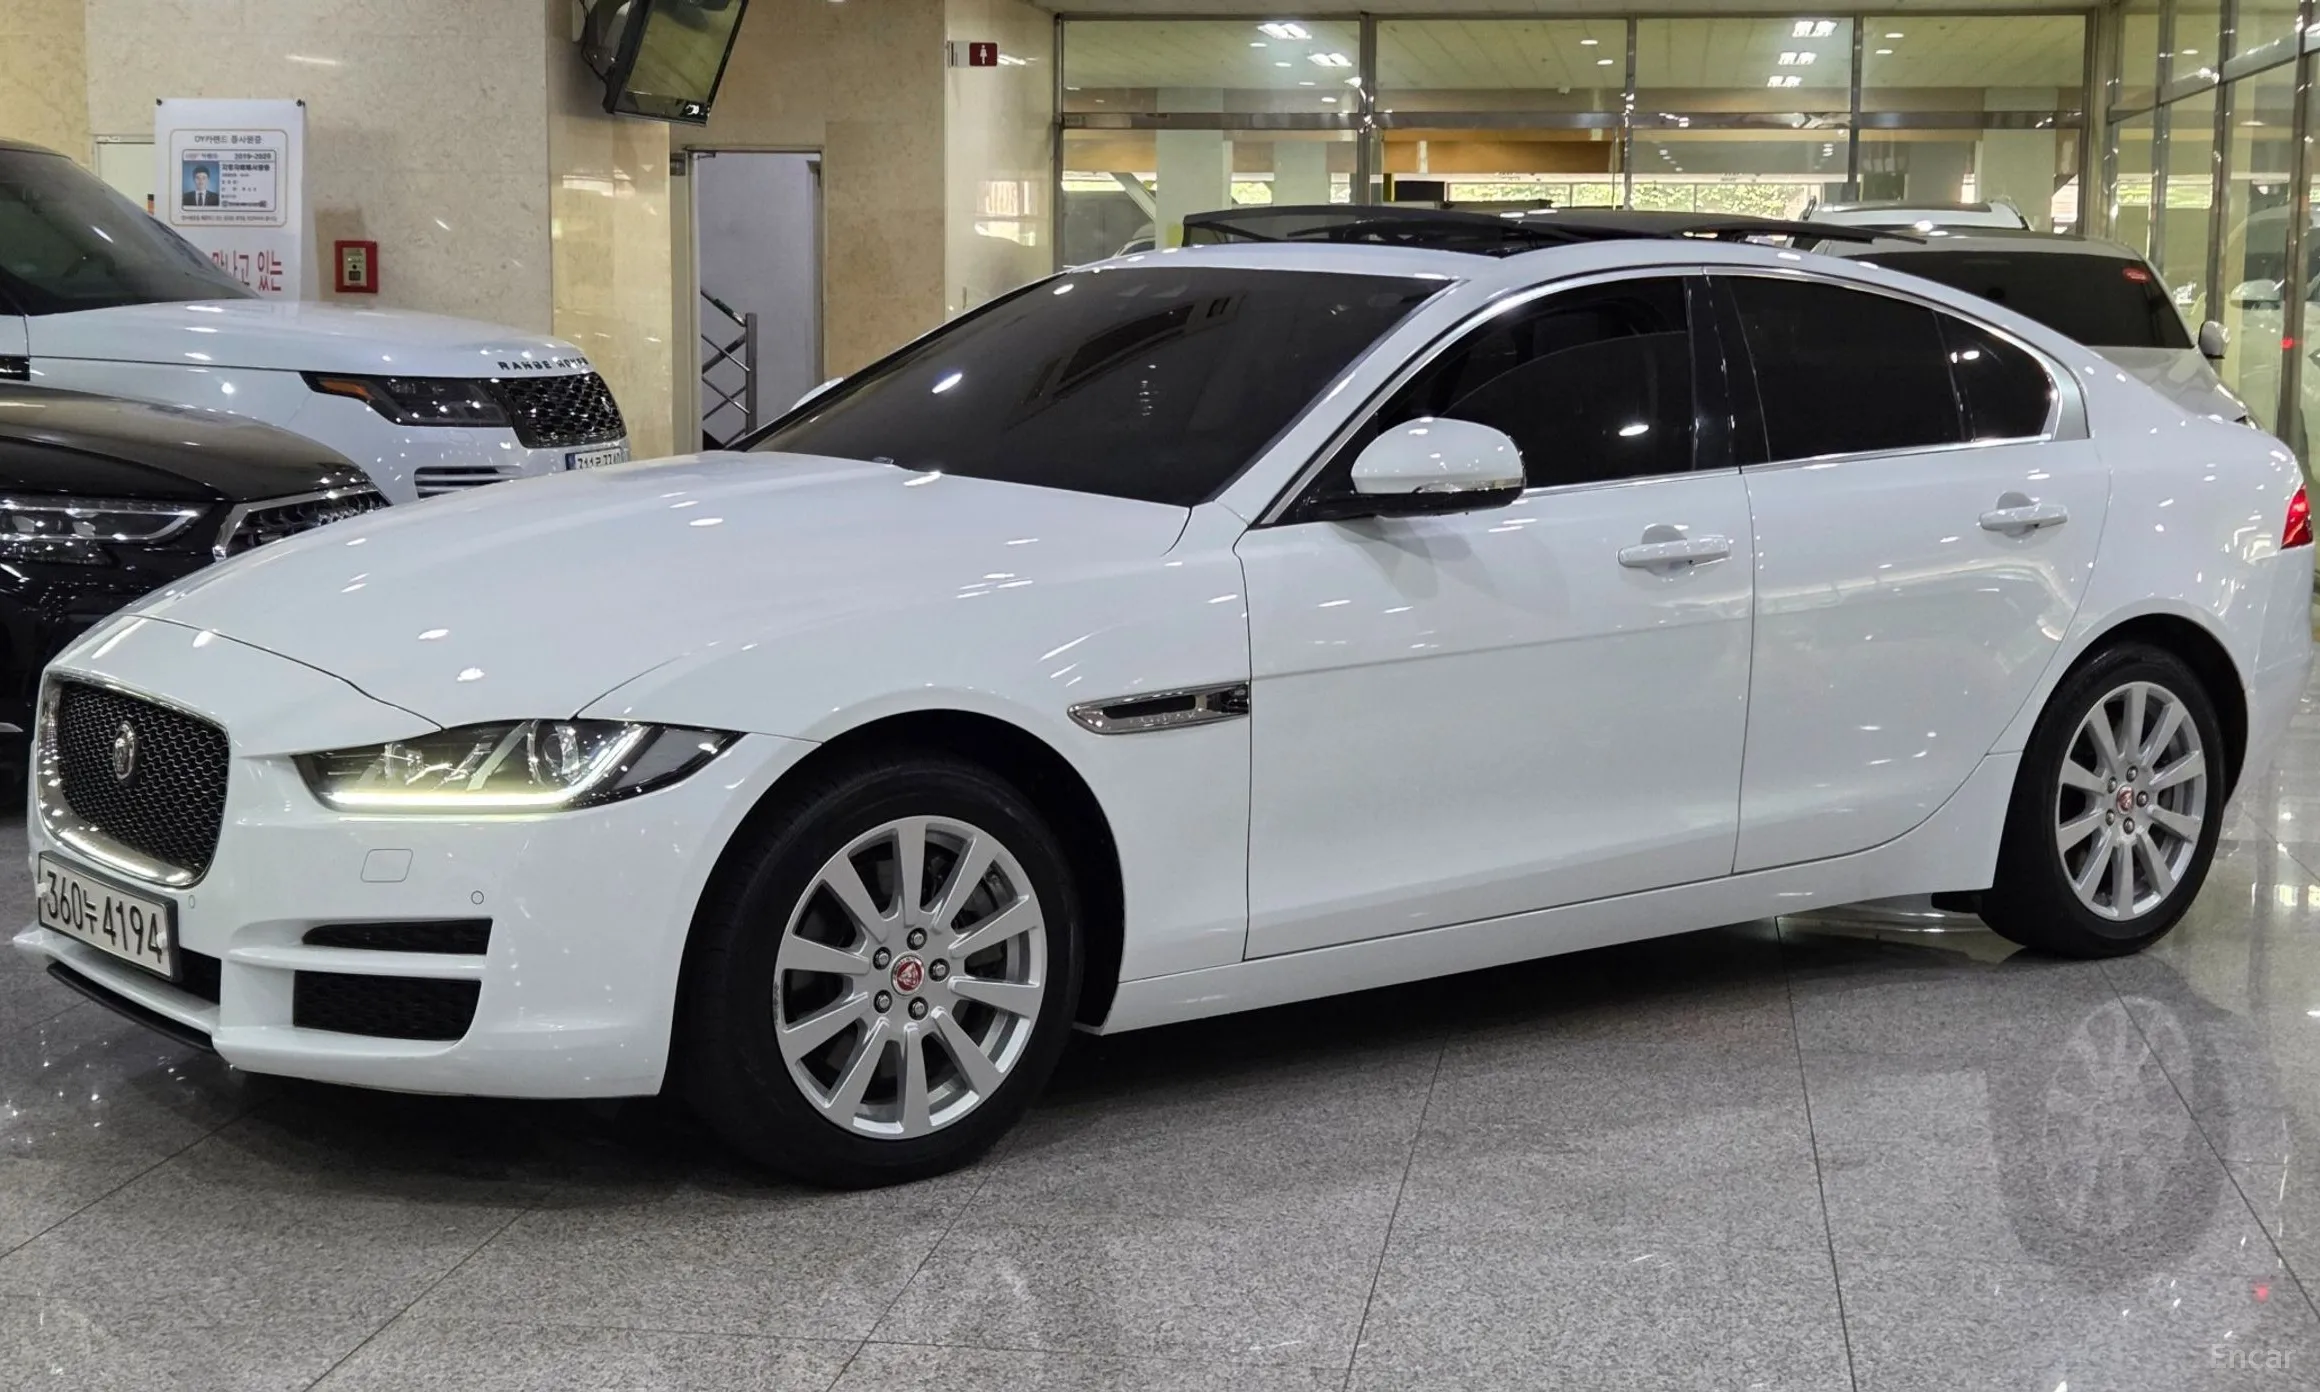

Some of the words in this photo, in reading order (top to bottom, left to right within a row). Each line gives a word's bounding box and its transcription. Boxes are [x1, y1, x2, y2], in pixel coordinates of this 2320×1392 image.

[258, 250, 283, 292] 있는
[497, 360, 553, 371] RANGE
[47, 870, 163, 964] 360누4194
